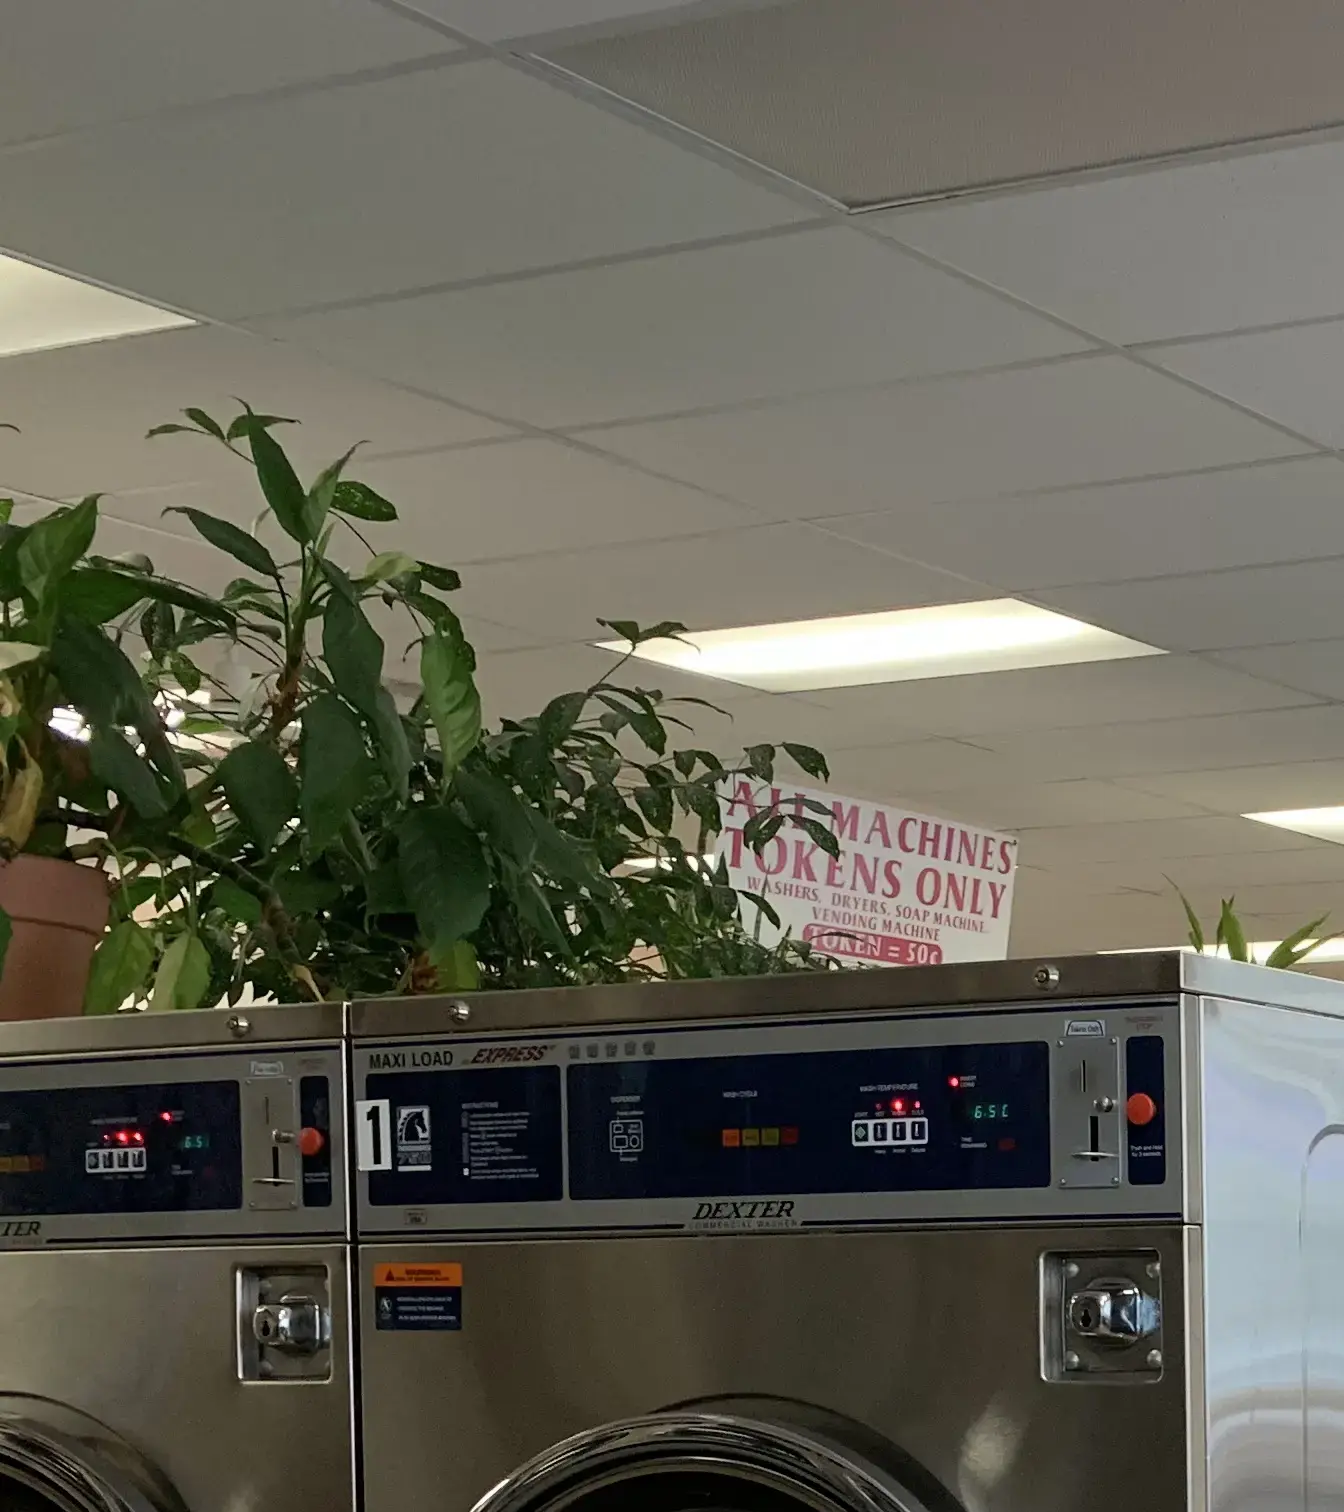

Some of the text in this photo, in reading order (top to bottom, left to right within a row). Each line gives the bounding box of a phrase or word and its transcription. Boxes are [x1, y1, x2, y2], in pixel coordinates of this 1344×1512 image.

[829, 800, 1013, 874] MACHINES
[724, 826, 1007, 919] TOKENS ONLY
[812, 906, 940, 941] VENDING MACHINE
[896, 904, 930, 923] SOAP
[809, 926, 882, 957] TOKEN
[369, 1051, 453, 1069] MAXI LOAD
[471, 1046, 548, 1064] EXPRESS
[366, 1106, 382, 1165] 1
[692, 1201, 795, 1219] DEXTER
